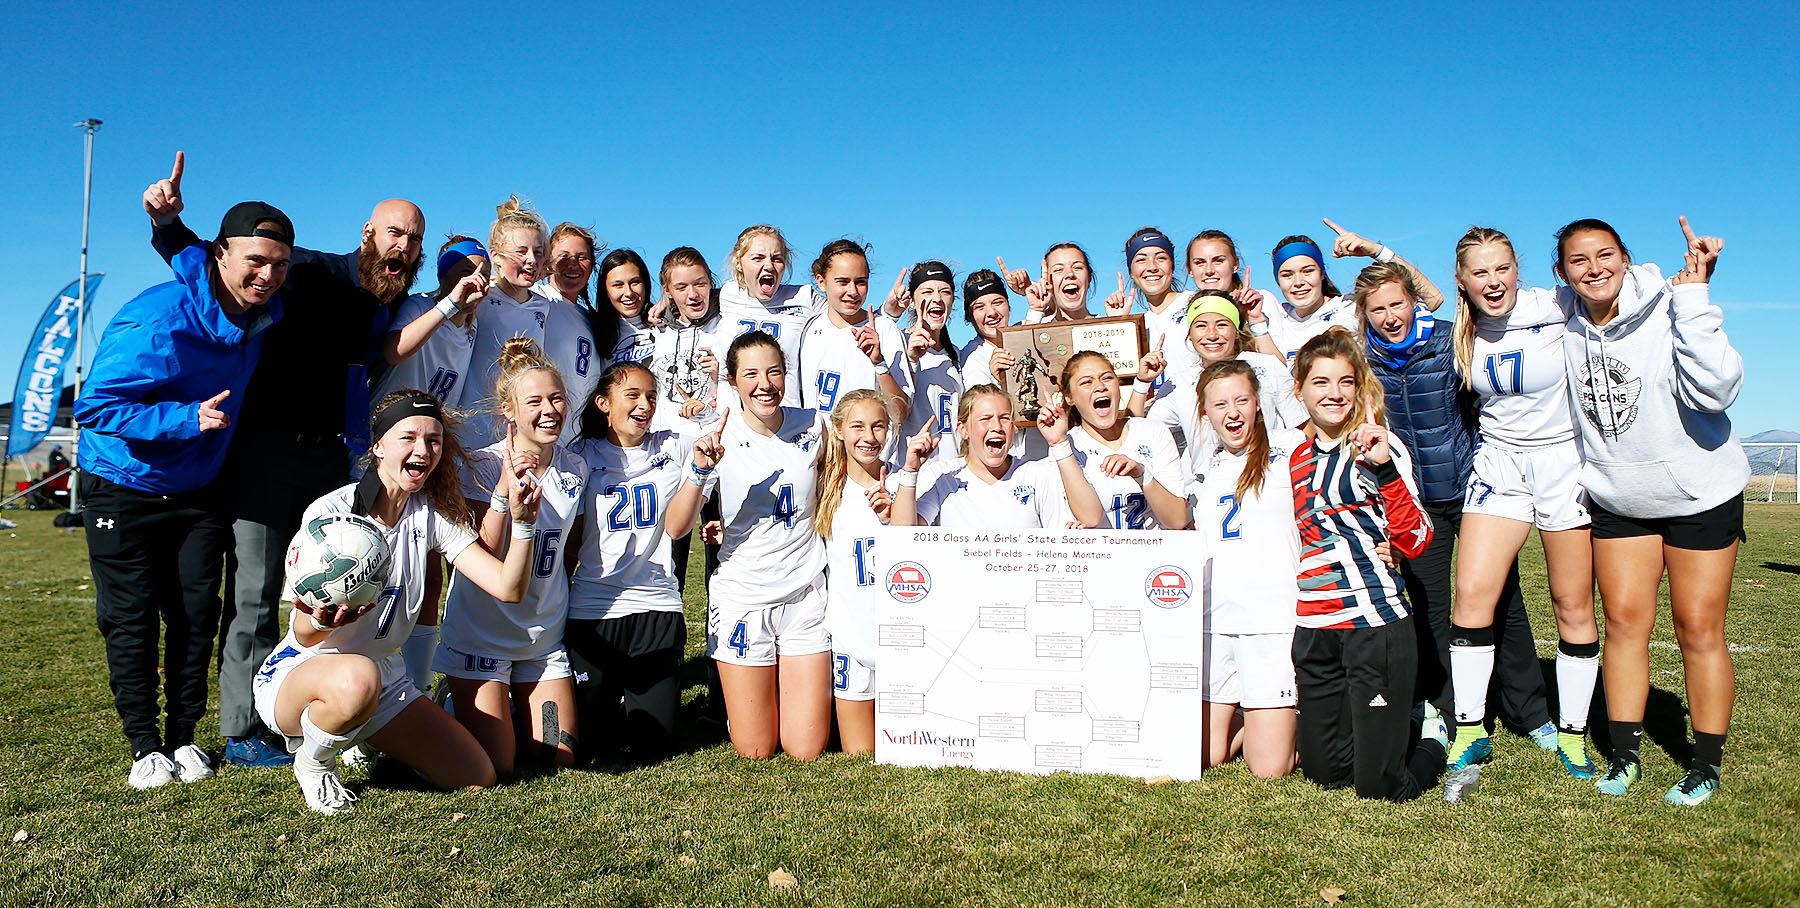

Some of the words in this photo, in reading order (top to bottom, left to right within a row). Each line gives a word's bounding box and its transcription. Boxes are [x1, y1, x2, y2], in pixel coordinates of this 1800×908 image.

[1083, 329, 1125, 339] 2018-2019
[1099, 341, 1111, 349] AA
[21, 295, 82, 432] FALCONS
[575, 335, 592, 378] 8
[1103, 351, 1119, 359] ATE
[665, 377, 699, 386] FACONS
[1483, 349, 1524, 396] 17
[815, 370, 842, 414] 19
[1583, 393, 1627, 403] FACONS
[604, 482, 659, 533] 20
[773, 483, 797, 530] 4
[1111, 493, 1149, 529] 12
[1217, 493, 1243, 541] 2
[913, 532, 939, 542] 2018
[943, 533, 969, 543] Class
[974, 534, 989, 543] AA
[994, 534, 1022, 544] Girls'
[1027, 535, 1056, 544] State
[1061, 535, 1097, 545] Soccer
[1102, 536, 1163, 546] Tournament
[963, 549, 992, 557] Siebel
[995, 549, 1023, 558] Fields
[1036, 550, 1068, 559] Helena
[1072, 551, 1112, 560] Montana
[344, 551, 382, 592] Baden
[985, 563, 1023, 572] October
[1027, 564, 1060, 574] 25-27,
[1065, 565, 1089, 573] 2018
[889, 584, 929, 593] MHSA
[1148, 588, 1190, 598] MHSA
[375, 585, 403, 639] 7
[727, 620, 750, 659] 4
[883, 729, 976, 747] NorthWestern
[941, 747, 976, 761] Energy
